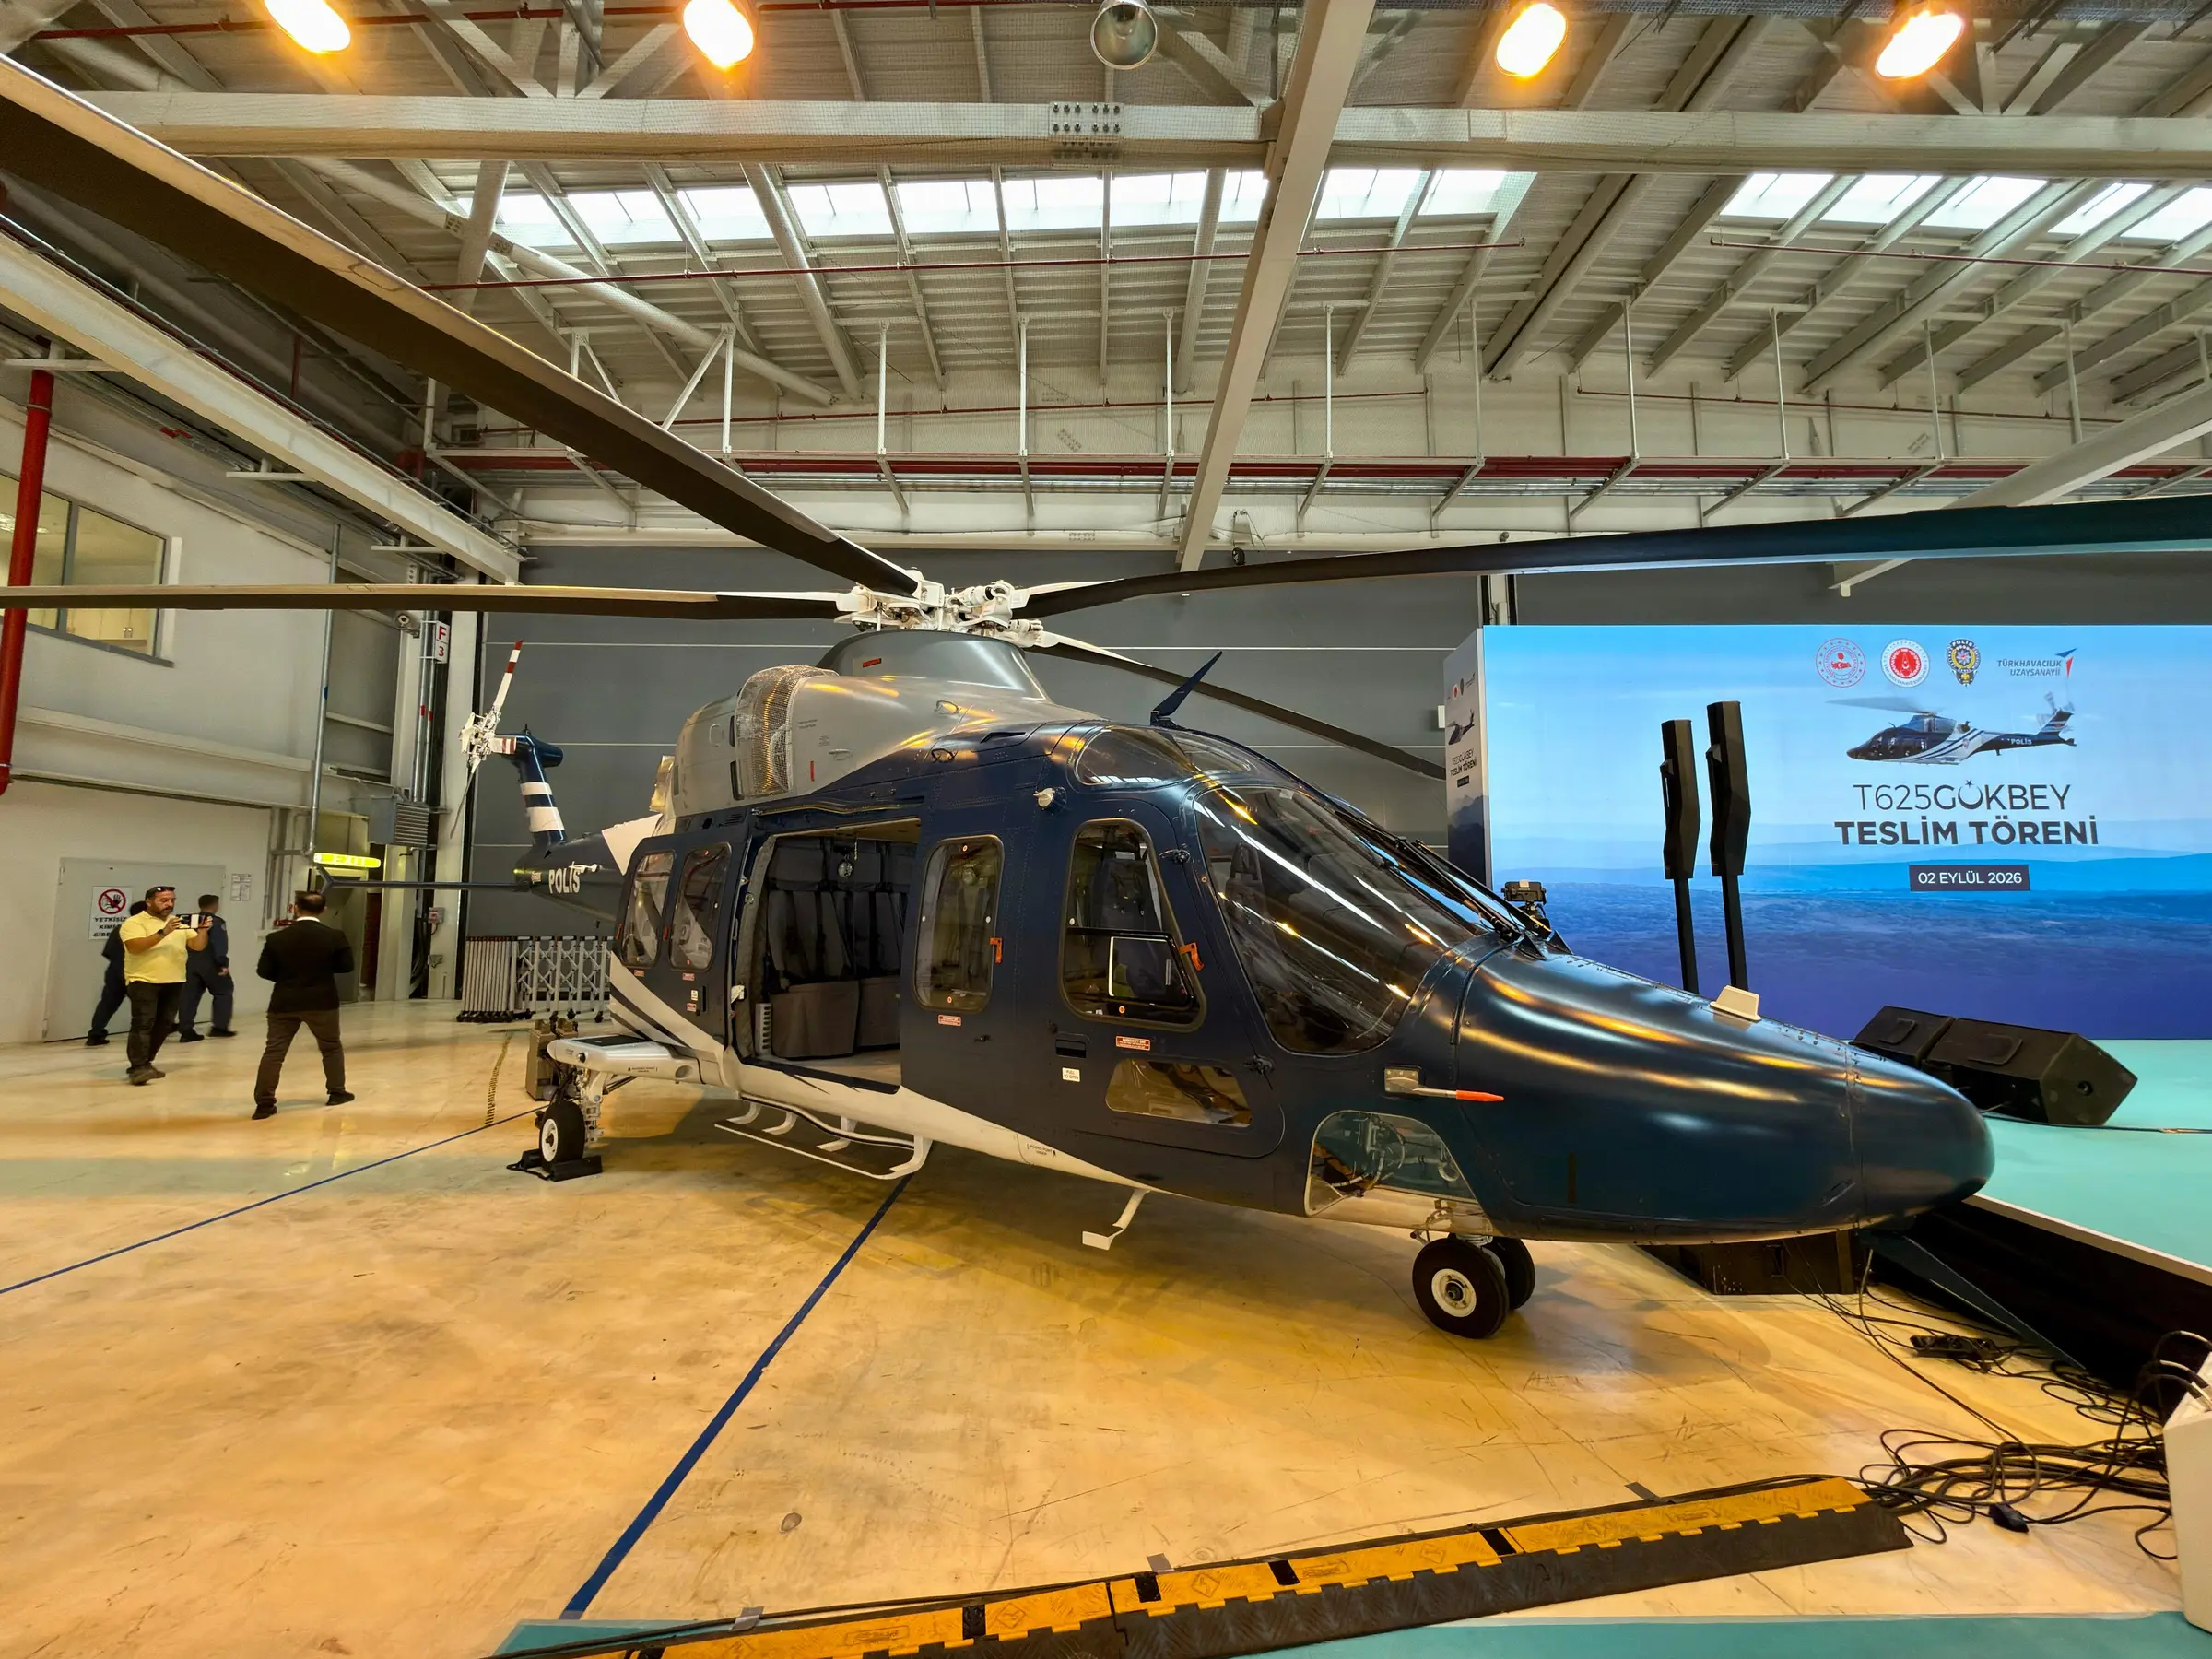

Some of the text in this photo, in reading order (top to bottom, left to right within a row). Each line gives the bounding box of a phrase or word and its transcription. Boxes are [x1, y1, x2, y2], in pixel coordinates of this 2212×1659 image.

[439, 625, 447, 640] F
[438, 646, 444, 656] 3
[1834, 815, 2099, 845] TESLİM TÖRENİ
[1917, 870, 2023, 884] 02 EYLÜL 2026
